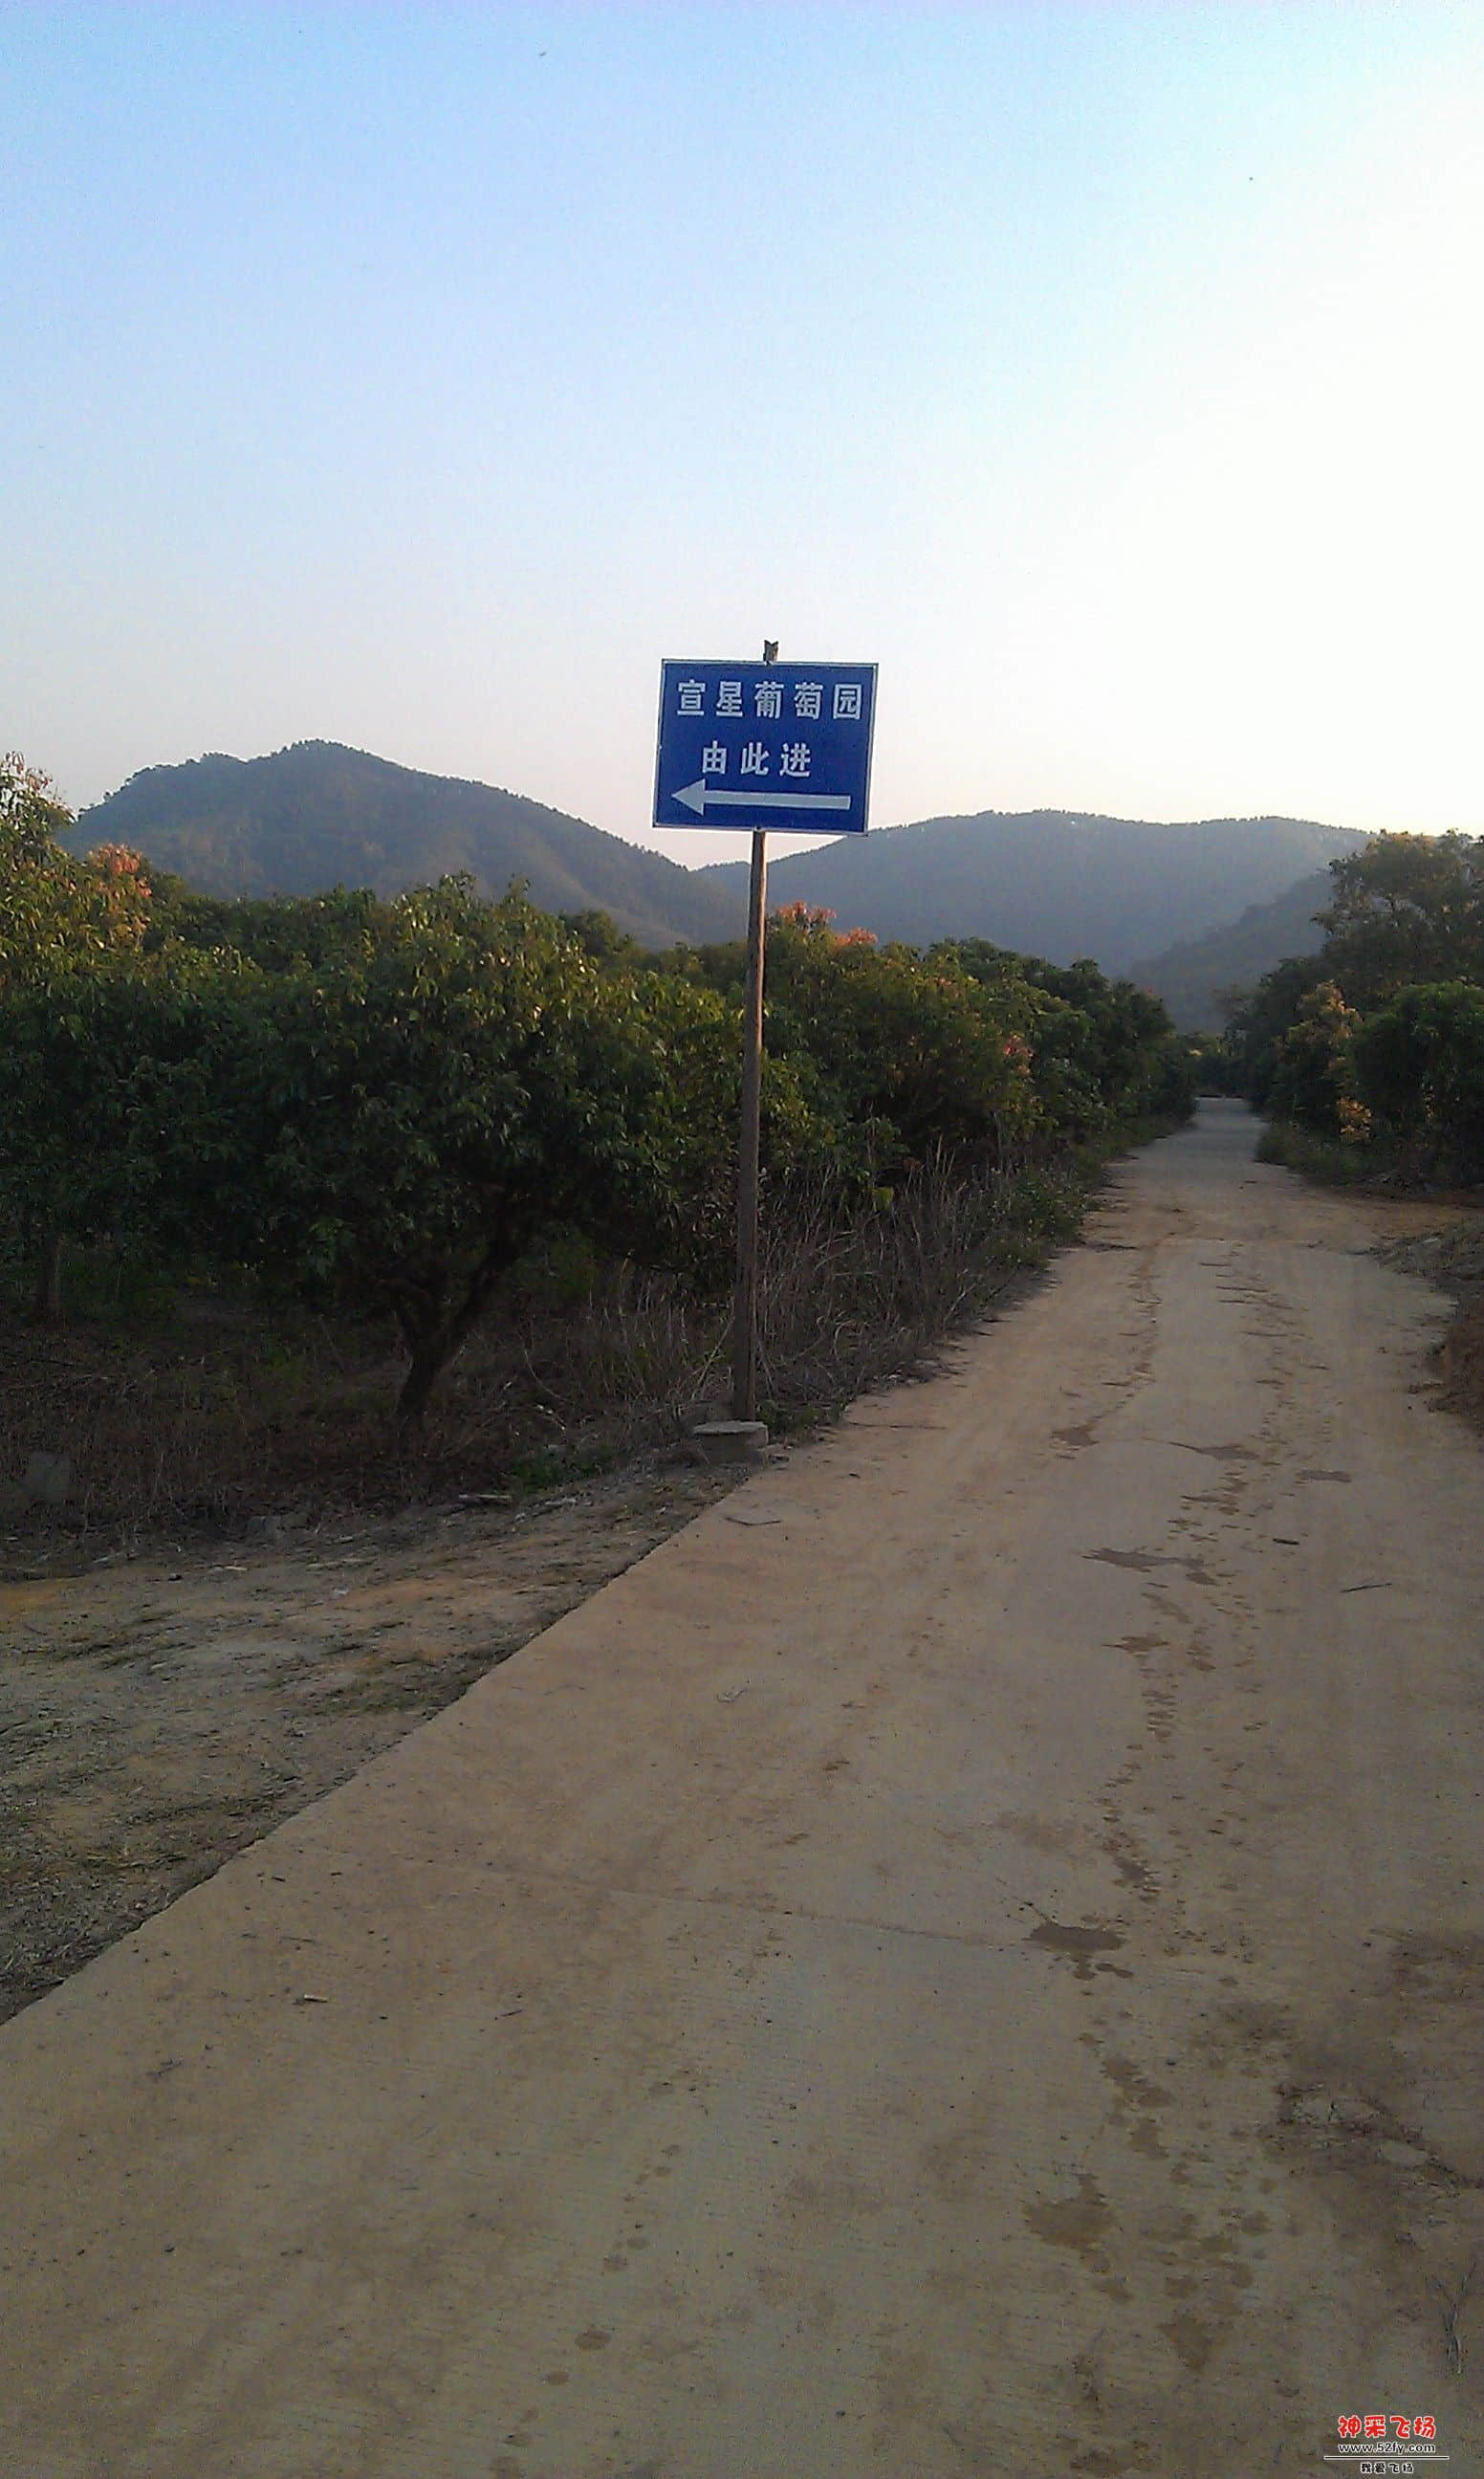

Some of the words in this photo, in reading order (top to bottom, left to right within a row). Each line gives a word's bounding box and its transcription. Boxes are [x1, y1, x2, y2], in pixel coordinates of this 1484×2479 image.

[677, 679, 862, 720] 宣星葡萄园
[702, 740, 811, 778] 由此进
